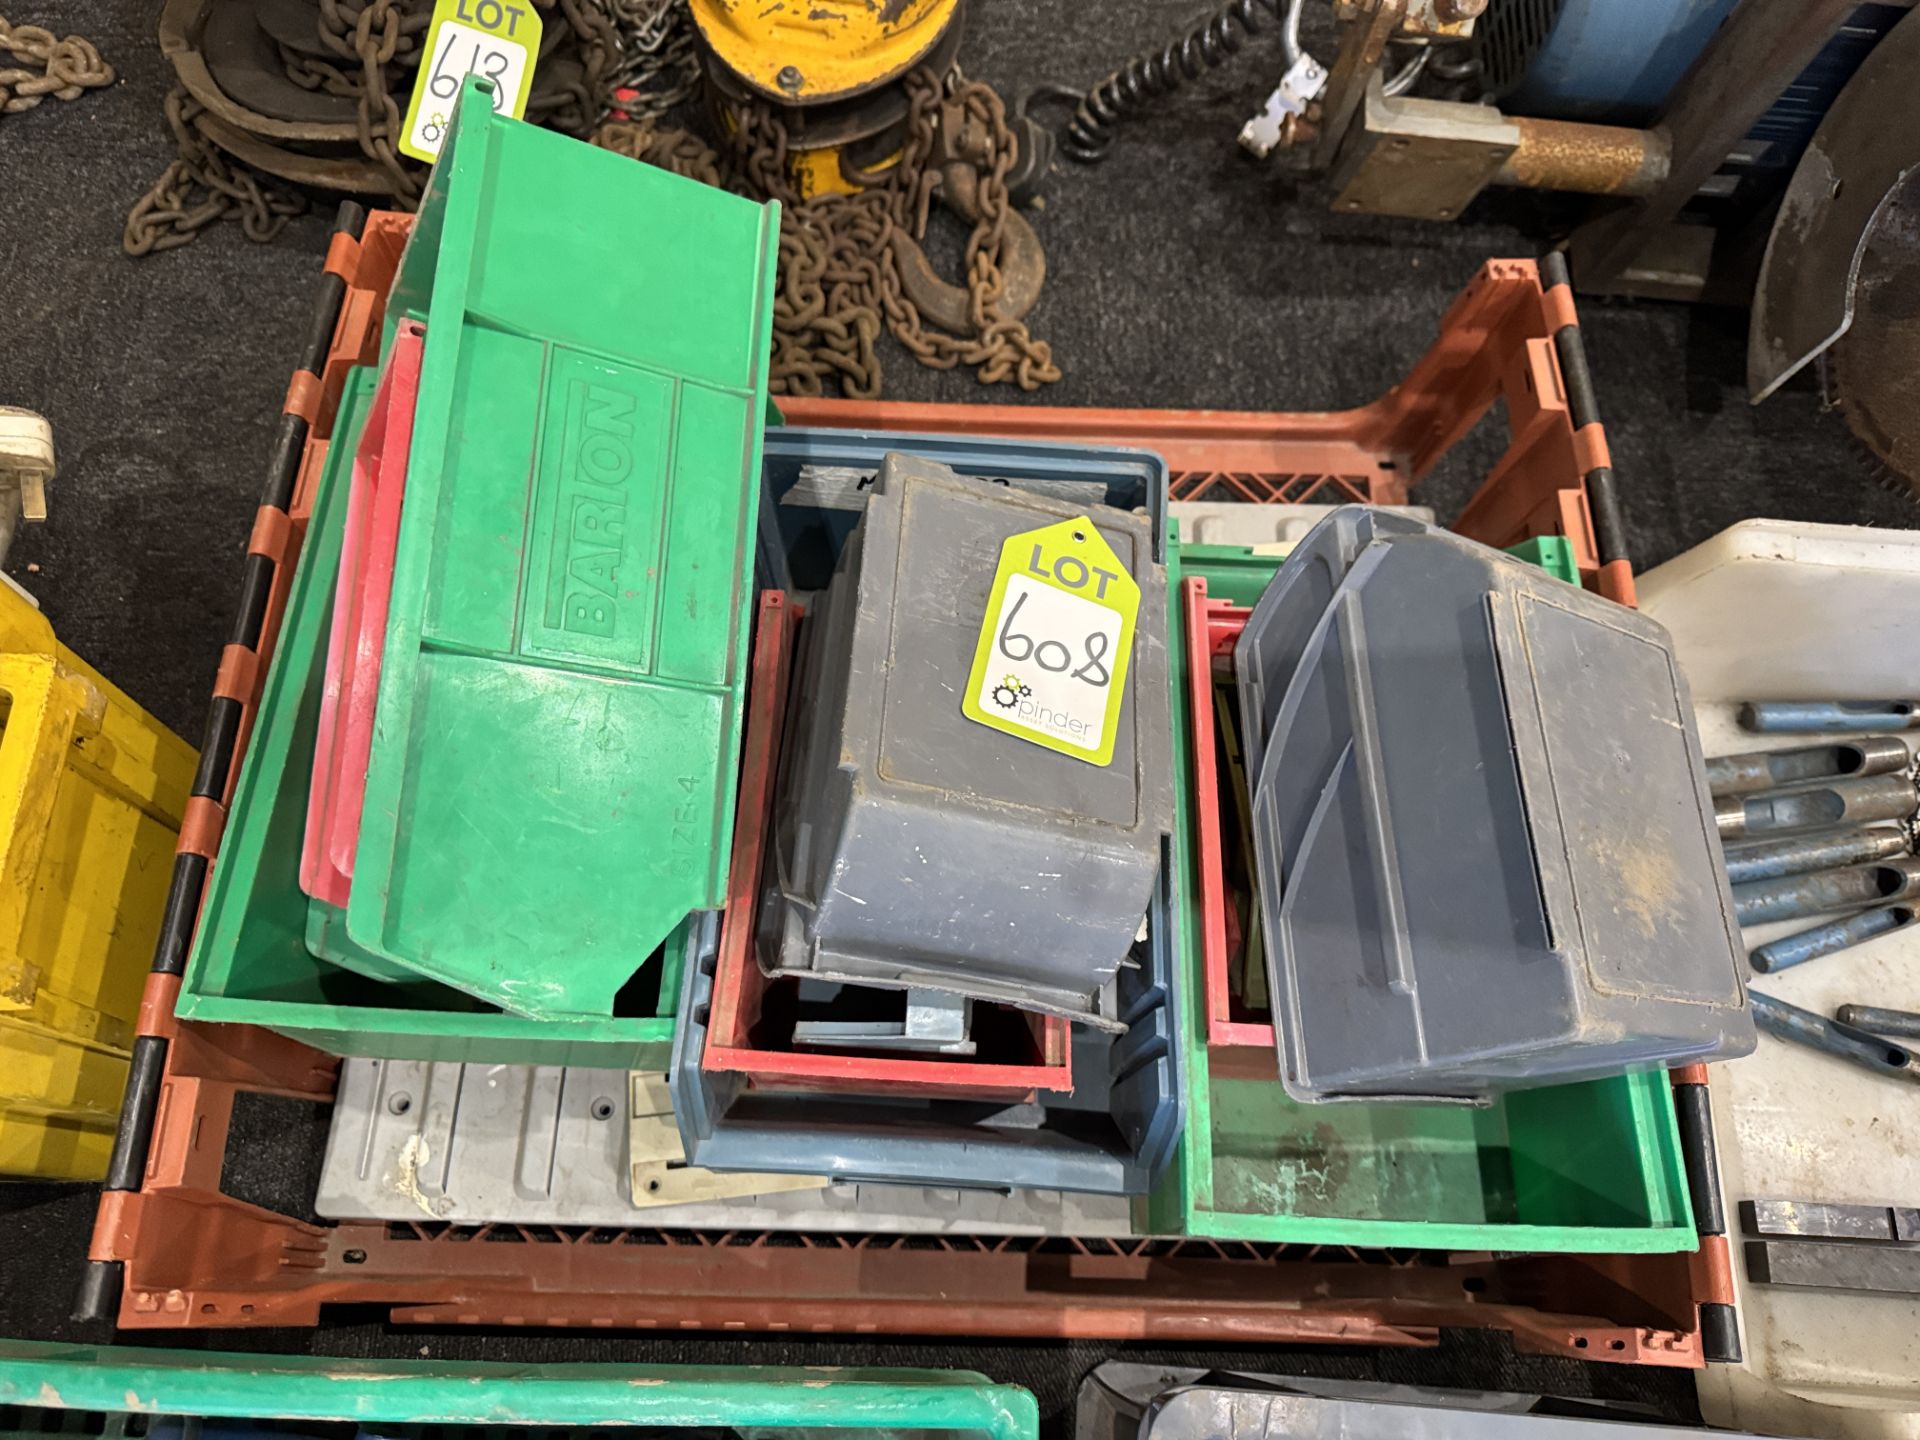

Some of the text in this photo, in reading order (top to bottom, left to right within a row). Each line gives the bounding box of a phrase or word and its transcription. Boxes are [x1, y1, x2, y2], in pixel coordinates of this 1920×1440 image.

[456, 0, 525, 36] LOT
[563, 383, 637, 638] BARION
[1028, 543, 1119, 600] LOT
[999, 591, 1110, 687] 608
[1018, 700, 1094, 736] pinder
